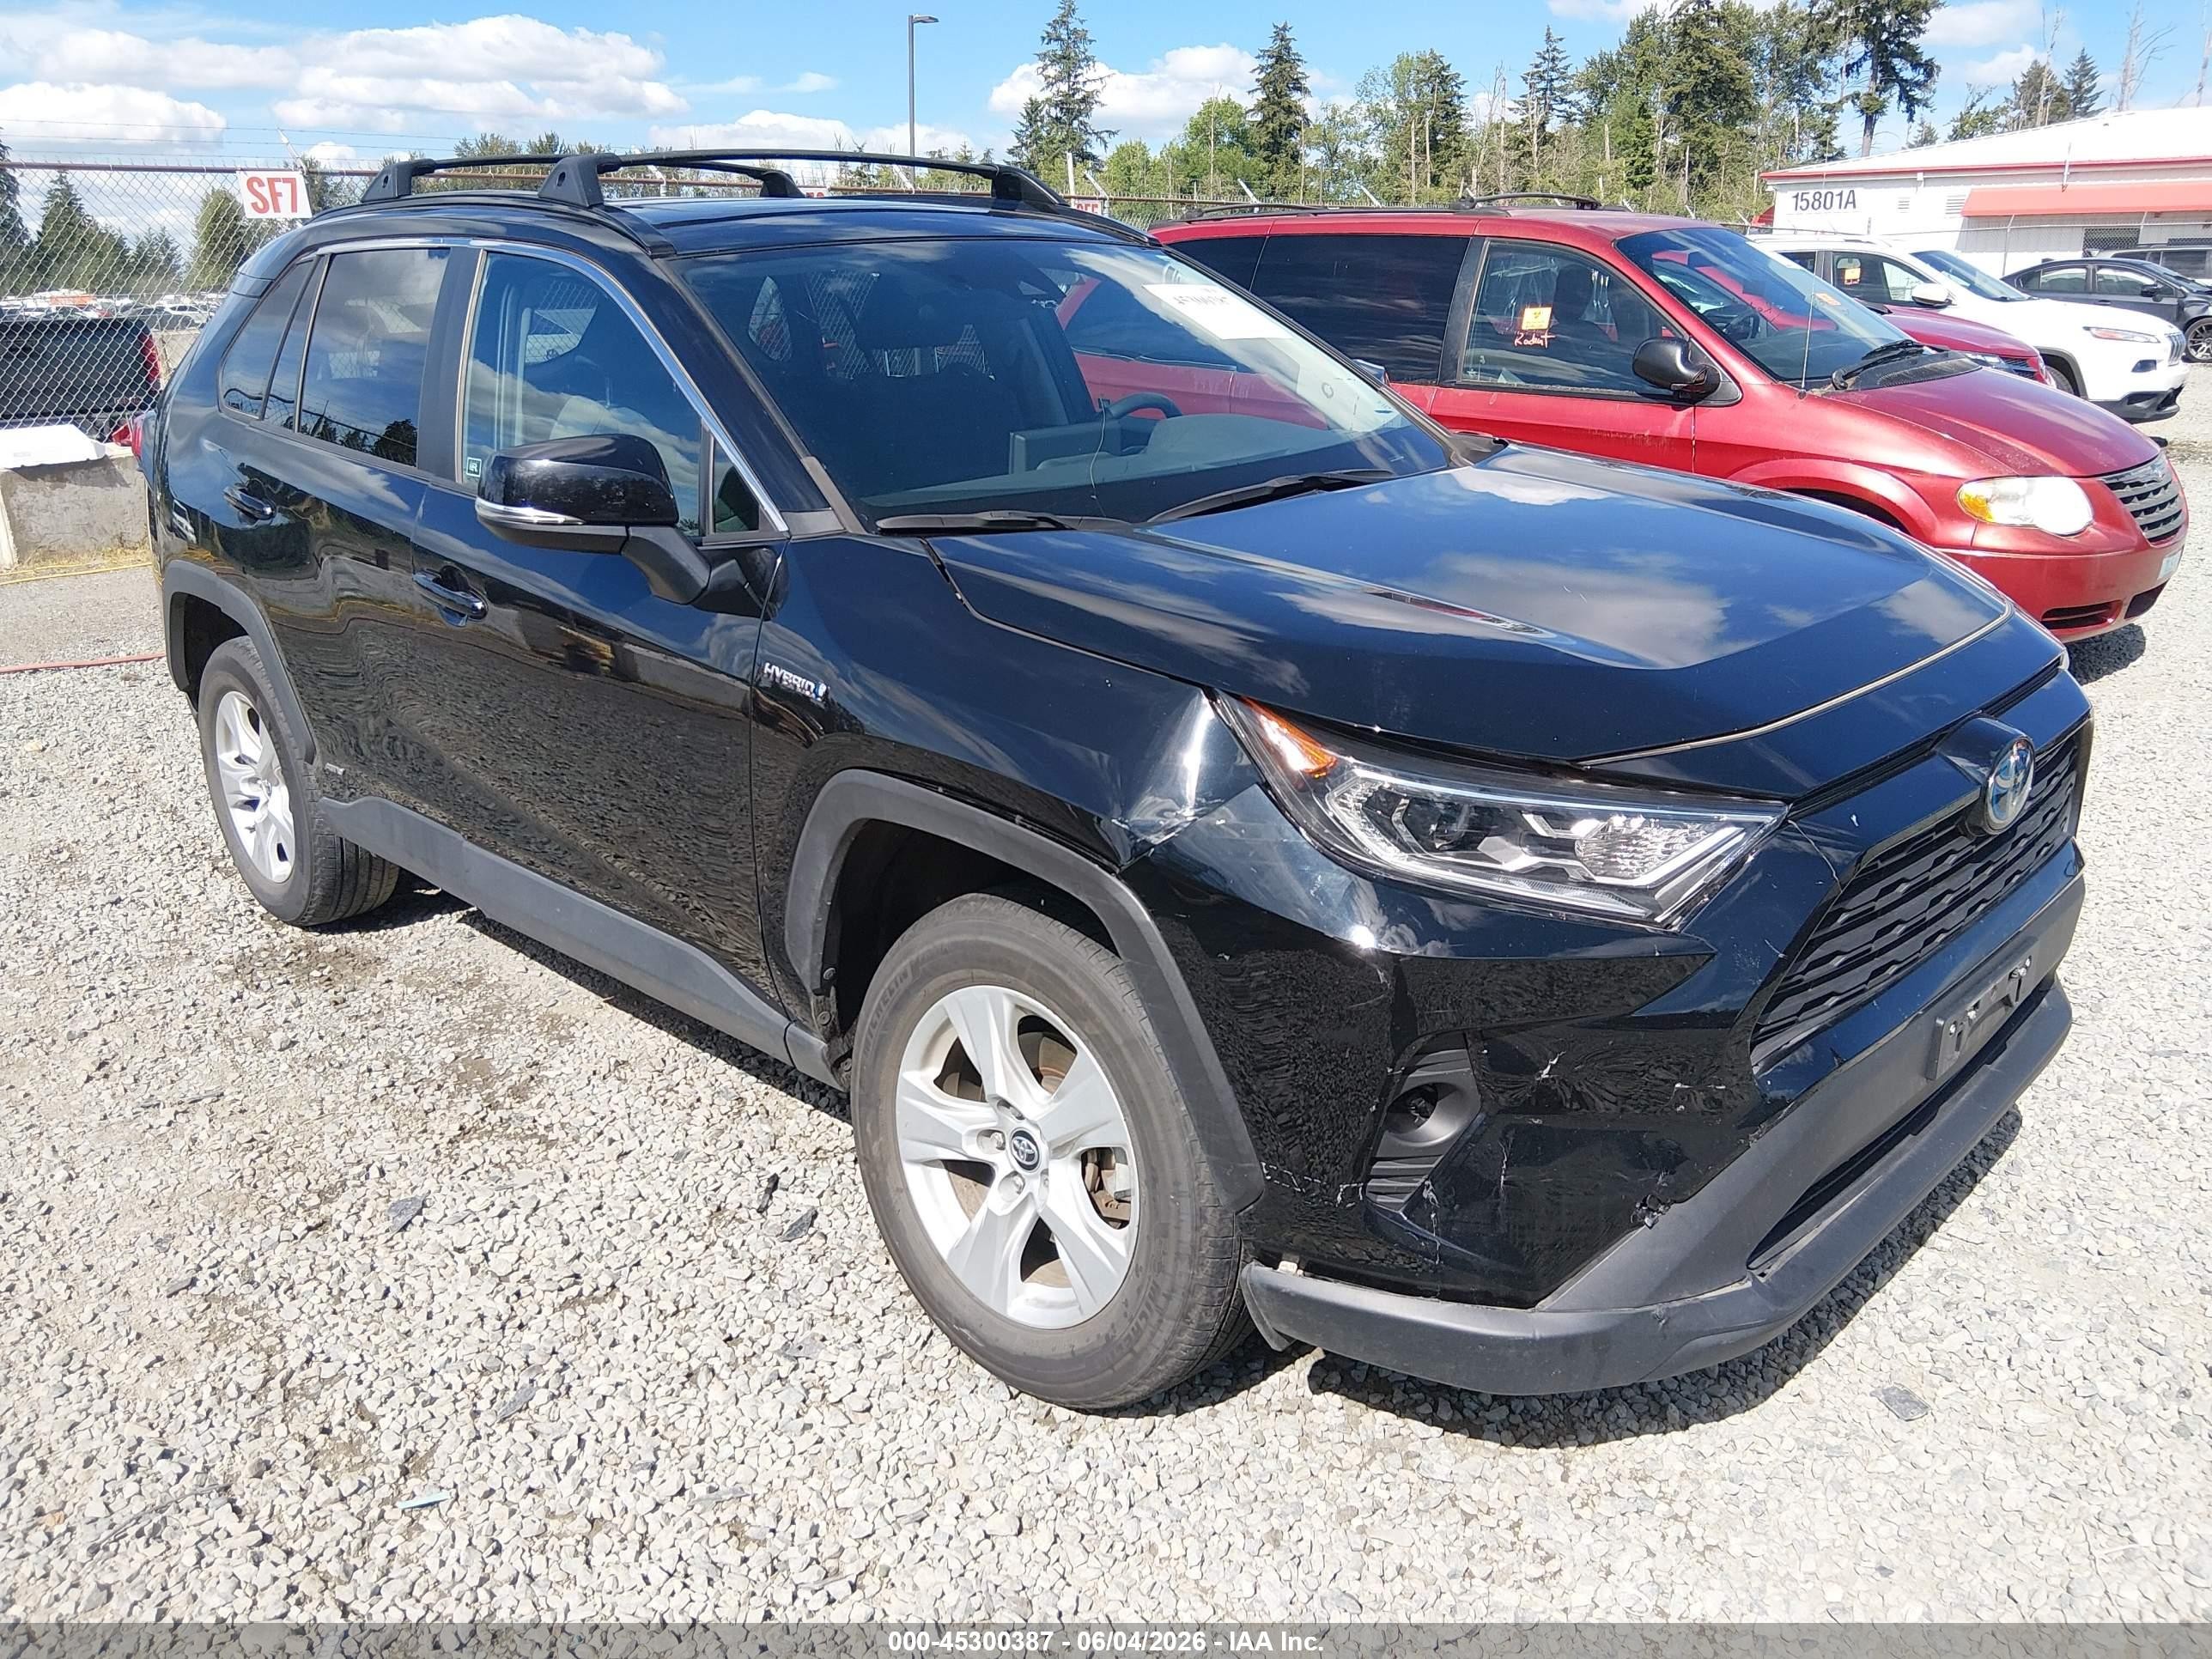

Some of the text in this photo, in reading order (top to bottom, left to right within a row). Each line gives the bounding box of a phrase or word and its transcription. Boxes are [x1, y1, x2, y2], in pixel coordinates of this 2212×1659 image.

[246, 176, 298, 214] SF7
[1792, 190, 1856, 211] 15801A
[763, 662, 816, 697] HYBRID
